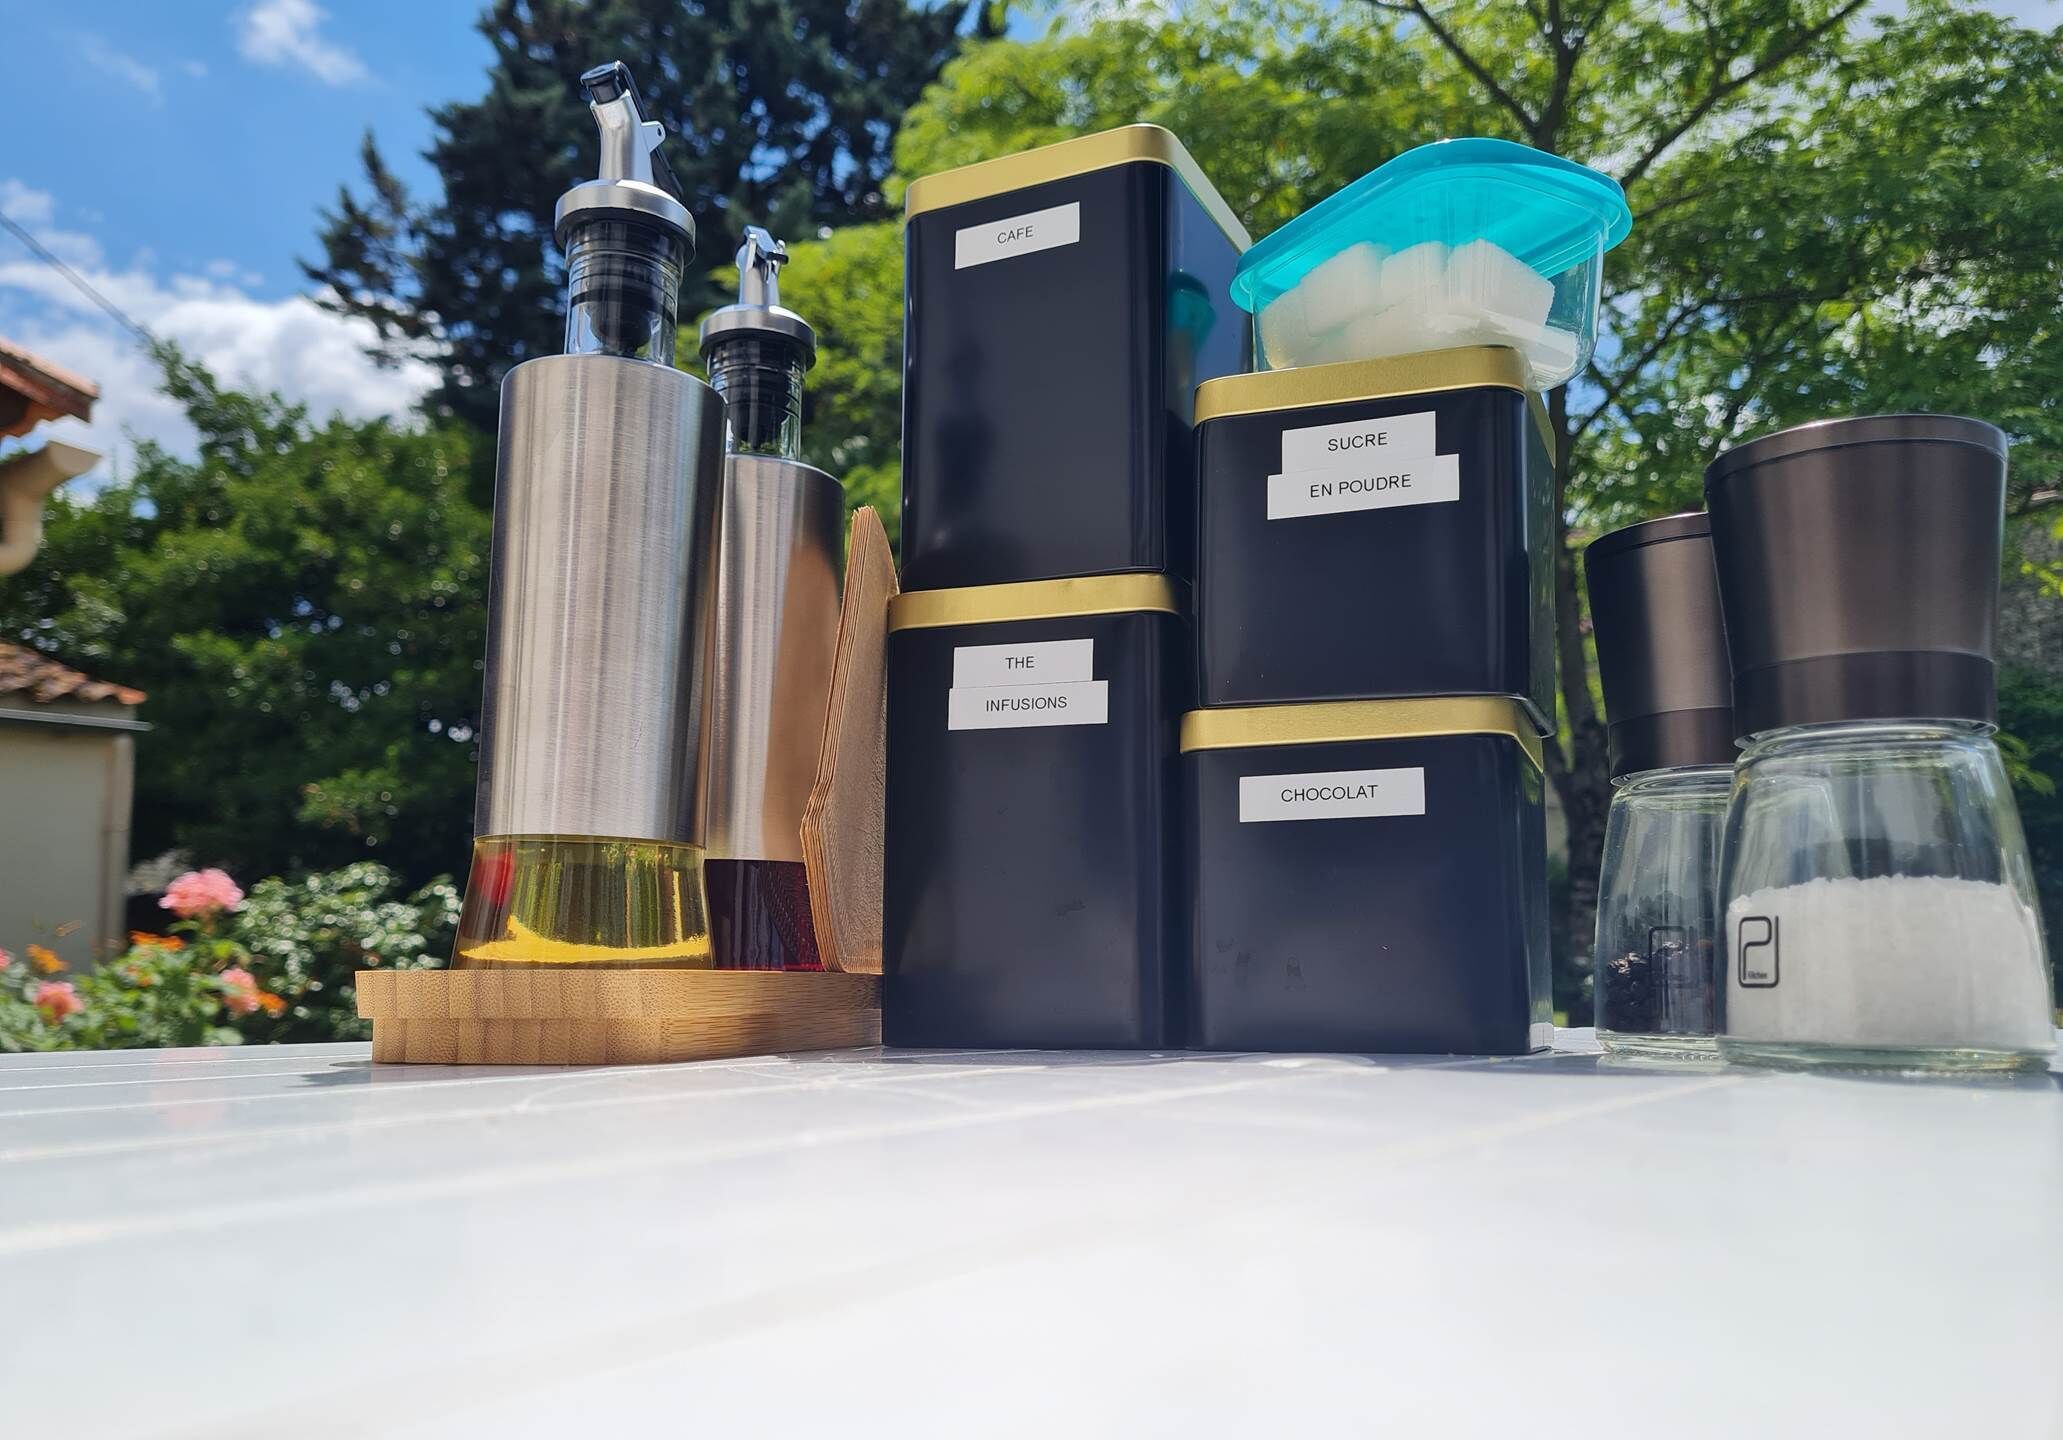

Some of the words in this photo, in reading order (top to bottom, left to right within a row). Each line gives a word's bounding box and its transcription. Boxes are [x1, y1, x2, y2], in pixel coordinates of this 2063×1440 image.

[997, 226, 1034, 244] CAFE
[1327, 432, 1388, 452] SUCRE
[1310, 484, 1332, 498] EN
[1338, 474, 1412, 495] POUDRE
[1005, 656, 1035, 670] THE
[985, 696, 1068, 712] INFUSIONS
[1281, 785, 1378, 802] CHOCOLAT
